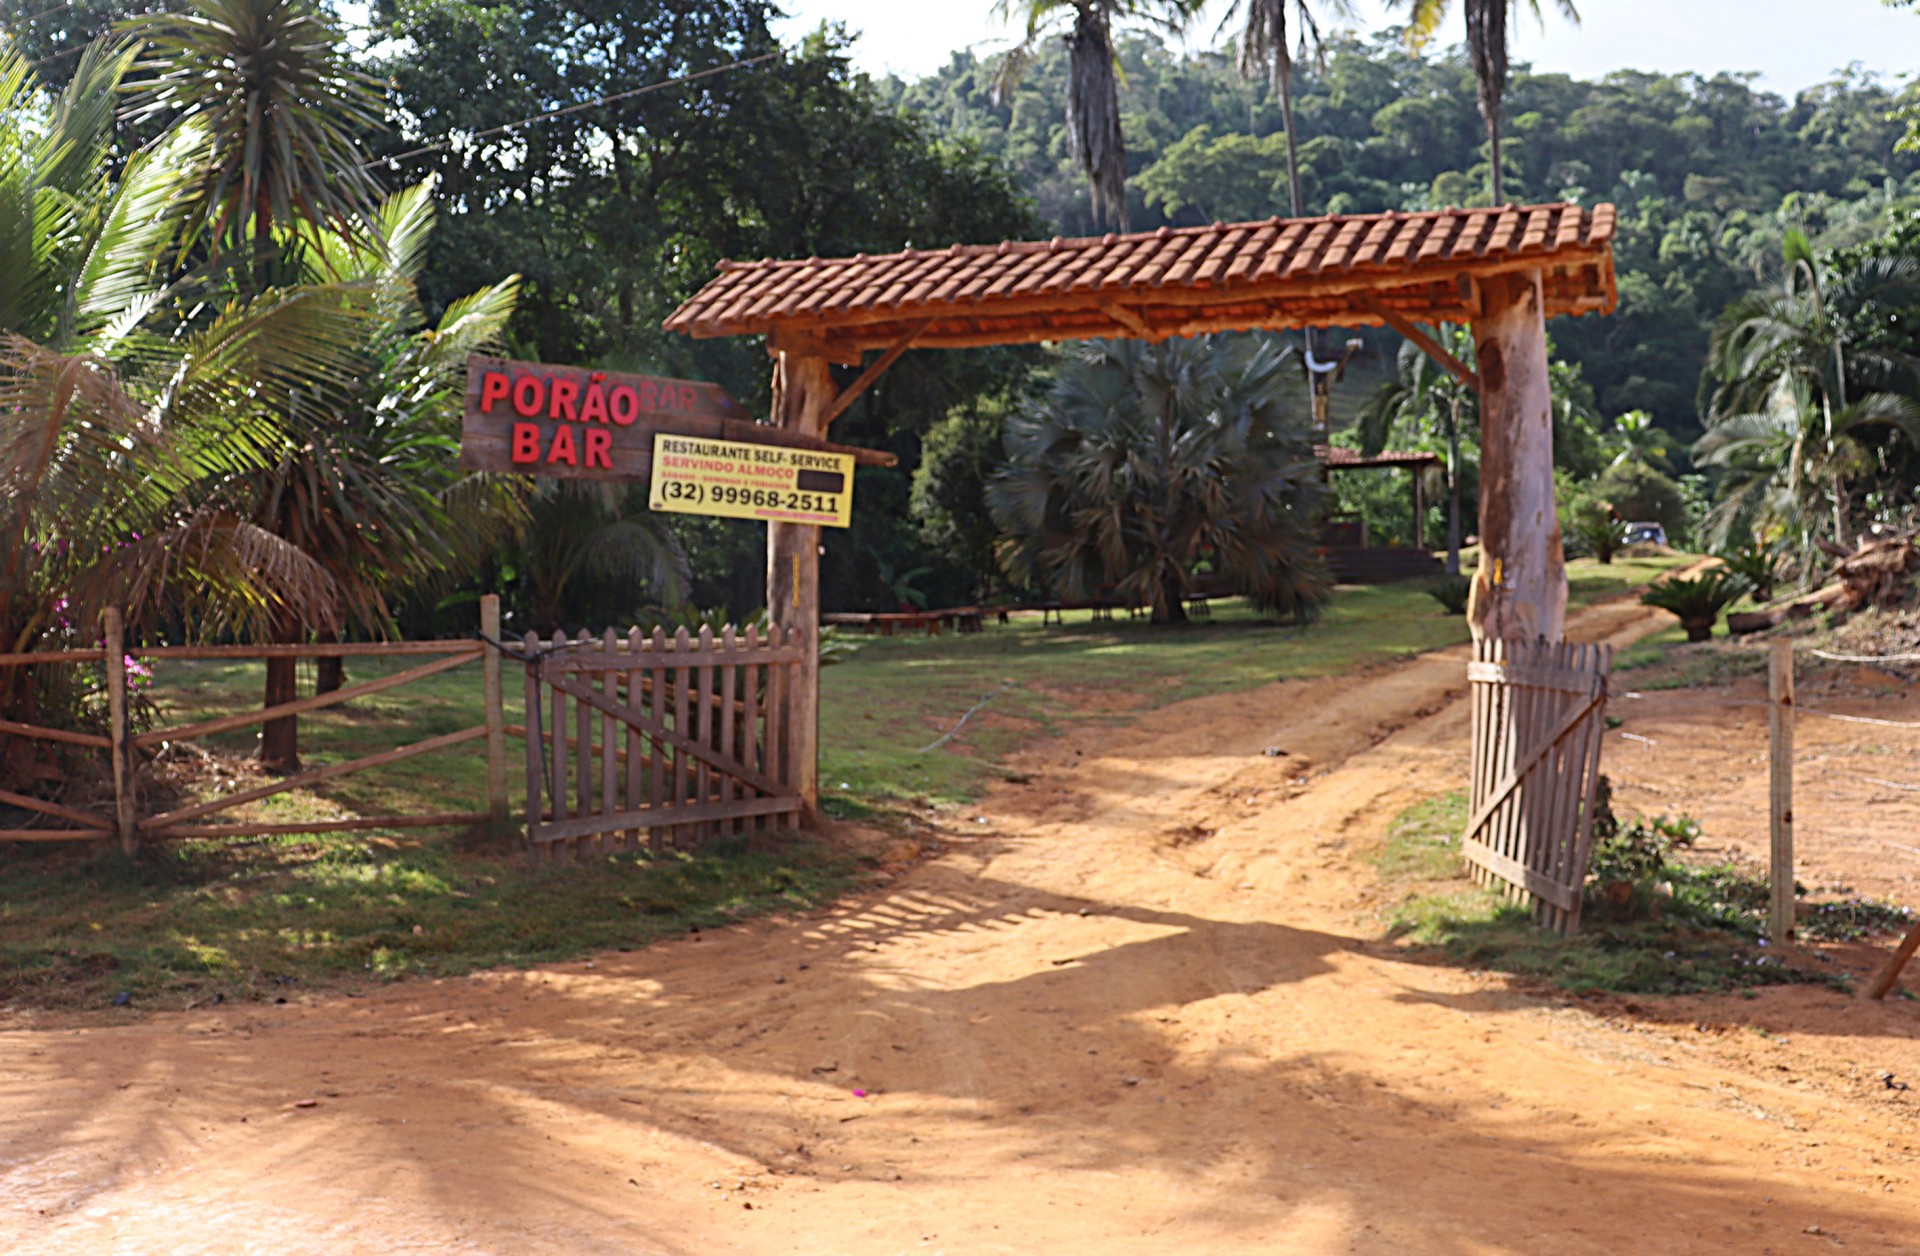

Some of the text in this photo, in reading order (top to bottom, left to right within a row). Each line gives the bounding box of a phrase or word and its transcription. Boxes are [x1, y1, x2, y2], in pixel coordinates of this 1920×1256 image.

[481, 371, 639, 426] PORÃO
[512, 421, 613, 469] BAR
[663, 439, 750, 461] RESTAURANTE
[662, 456, 794, 480] SERVINDO ALMOÇO
[661, 481, 839, 513] (32) 99968-2511
